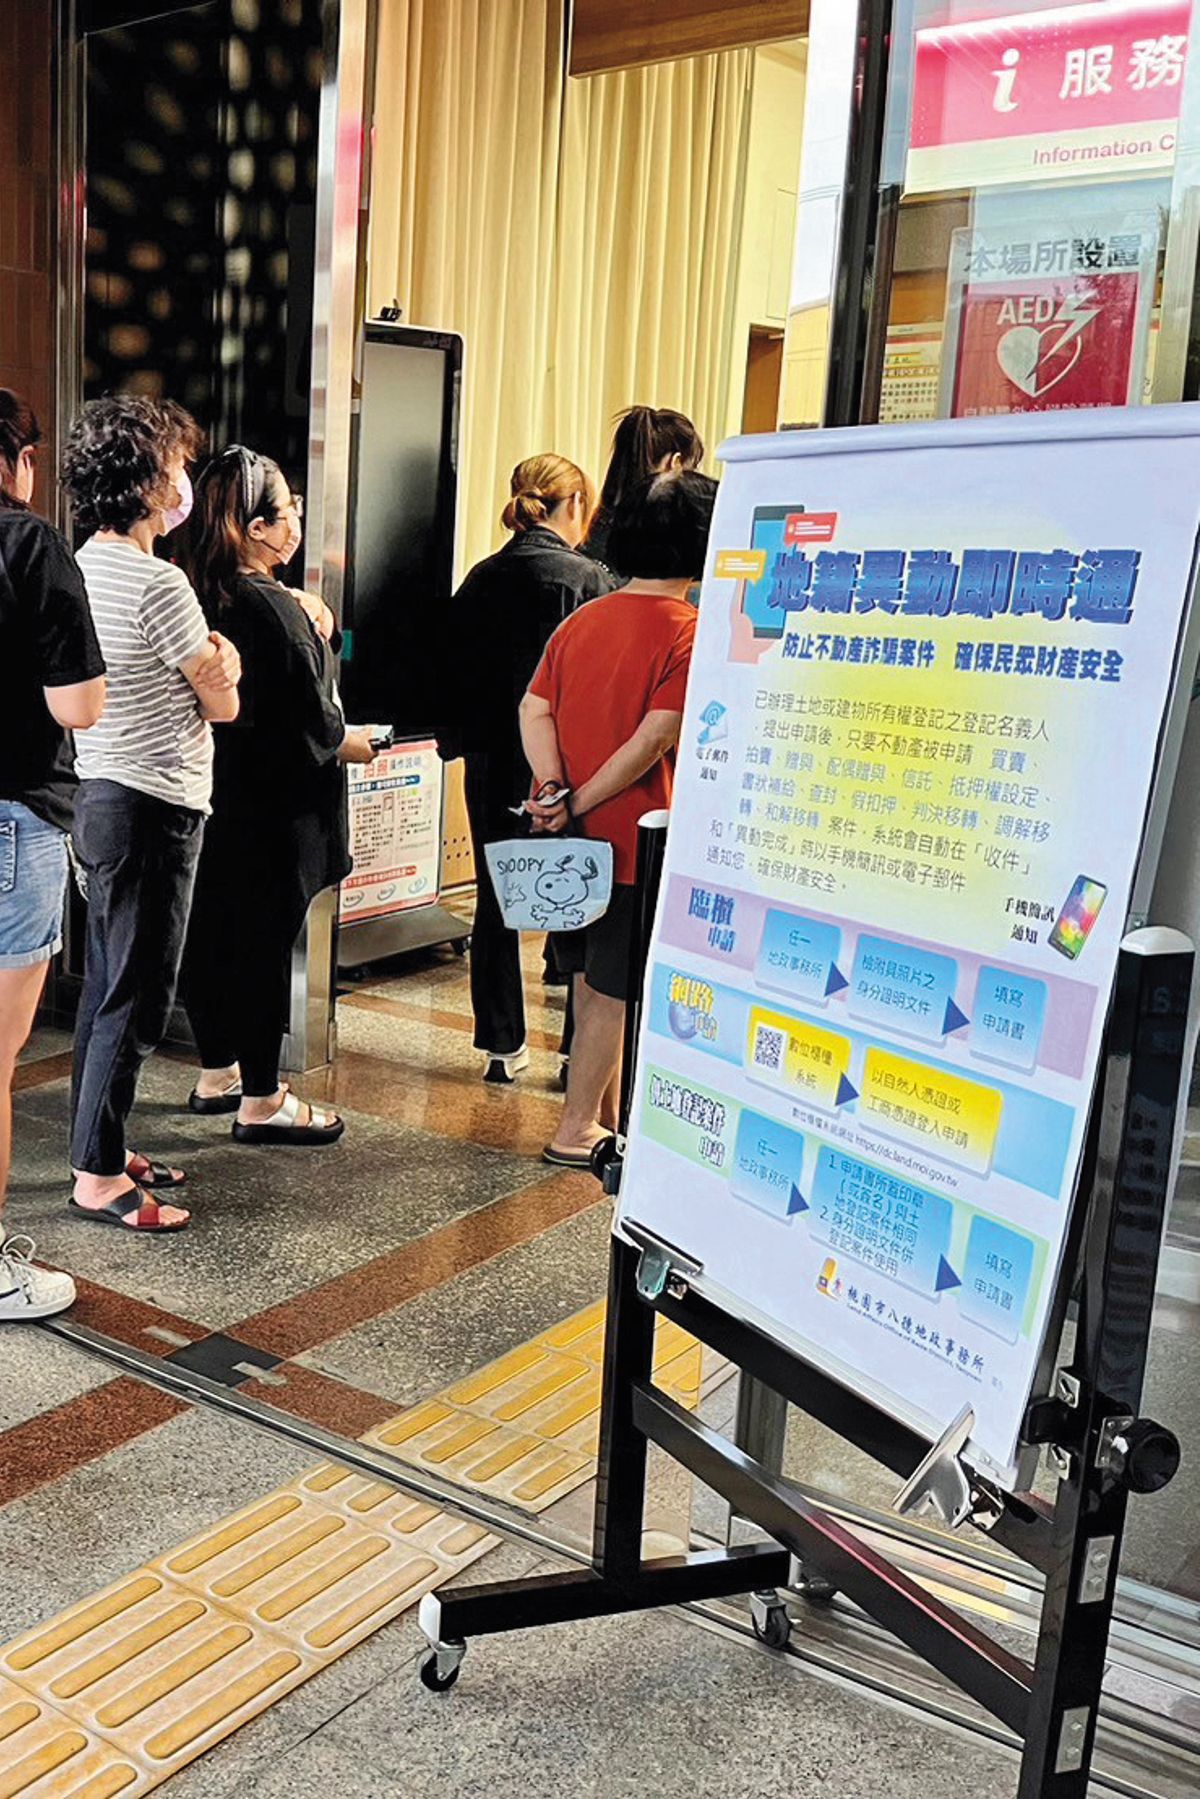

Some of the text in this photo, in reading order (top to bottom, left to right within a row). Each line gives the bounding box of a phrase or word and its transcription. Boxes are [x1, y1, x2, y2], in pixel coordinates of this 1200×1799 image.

[1058, 34, 1187, 100] 服務
[1033, 139, 1152, 165] Information
[964, 234, 1142, 278] 本場所設置
[997, 297, 1056, 325] AED
[767, 546, 1142, 625] 地籍異動即時通
